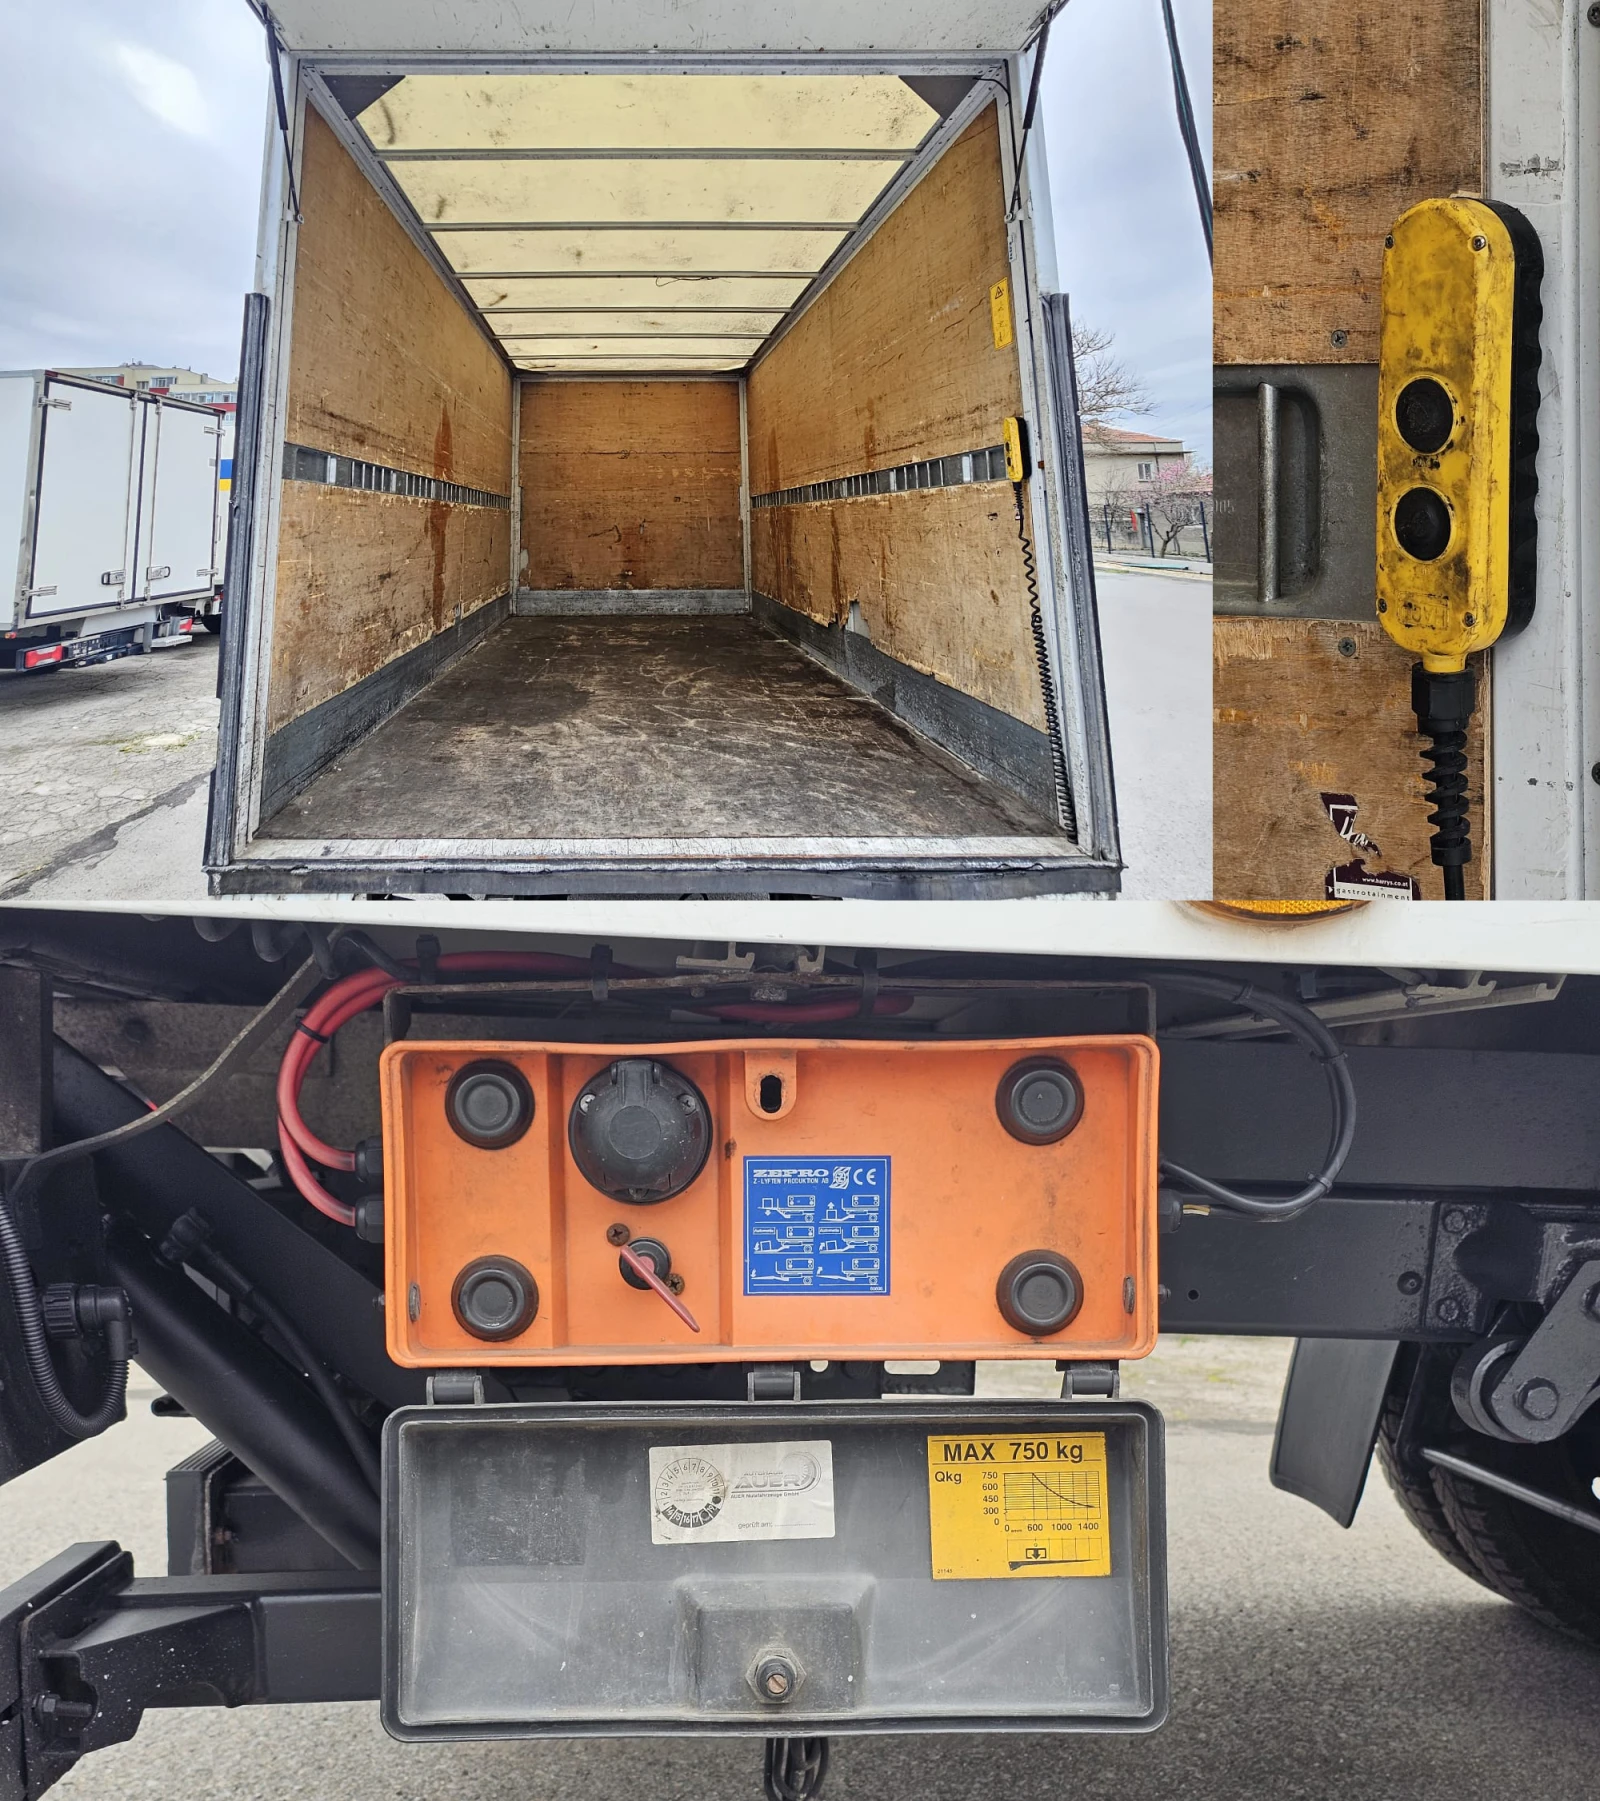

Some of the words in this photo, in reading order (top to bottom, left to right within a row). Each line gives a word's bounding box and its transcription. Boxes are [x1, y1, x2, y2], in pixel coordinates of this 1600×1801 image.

[1336, 888, 1410, 900] gastrotainment
[753, 1169, 829, 1177] ZEPRO
[944, 1442, 995, 1462] MAX
[1009, 1442, 1049, 1460] 750
[1056, 1441, 1083, 1463] kg
[734, 1474, 800, 1489] AUER
[934, 1471, 962, 1484] Qkg
[738, 1522, 760, 1530] geprüft
[1078, 1522, 1099, 1530] 1400
